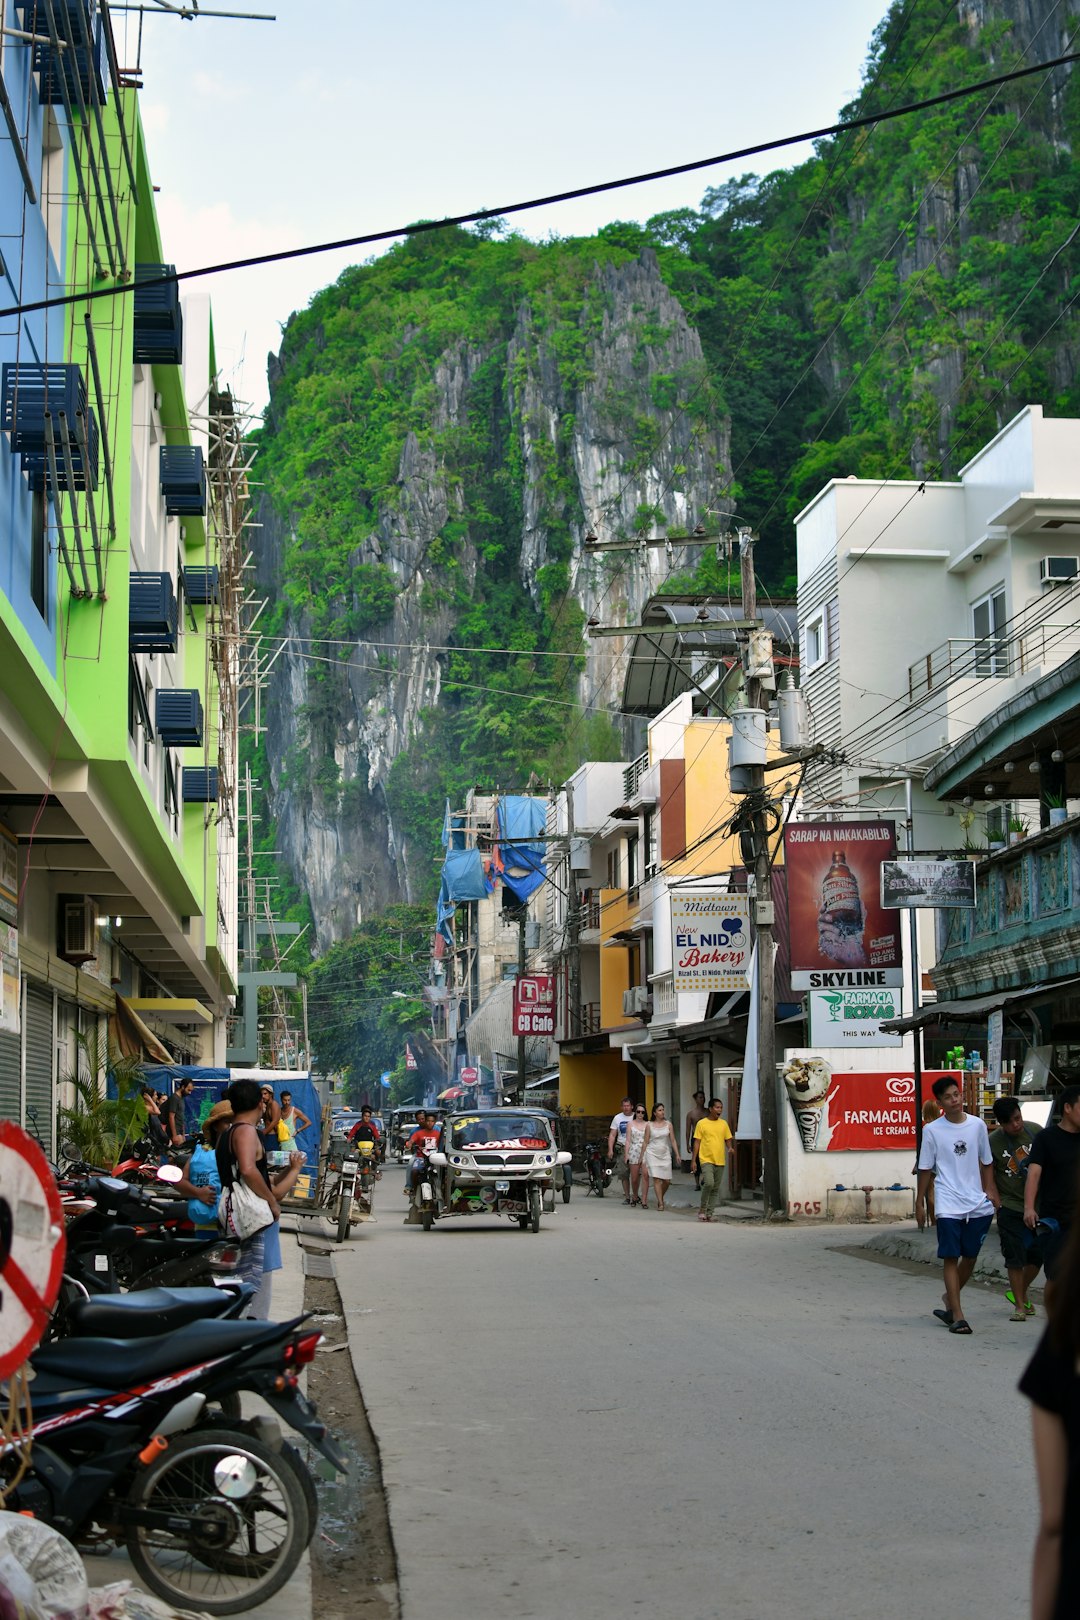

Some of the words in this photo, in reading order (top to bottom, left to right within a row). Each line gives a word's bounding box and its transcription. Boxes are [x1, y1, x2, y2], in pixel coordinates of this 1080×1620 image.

[789, 830, 818, 843] SARAP
[820, 829, 832, 841] NA
[833, 828, 890, 841] NAKAKABILIB
[684, 902, 737, 912] Midtown
[676, 924, 698, 935] New
[676, 934, 697, 947] EL
[679, 948, 745, 968] Bakery
[870, 953, 896, 965] BEER
[809, 971, 887, 988] SKYLINE
[844, 991, 894, 1005] FARMACIA
[844, 1005, 896, 1020] ROXAS
[518, 1014, 531, 1031] CB
[532, 1015, 553, 1031] Cafe
[844, 1109, 912, 1124] FARMACIA
[873, 1127, 883, 1136] ICE
[886, 1126, 909, 1135] CREAM
[462, 1139, 527, 1149] JOHN
[500, 1200, 524, 1212] 700
